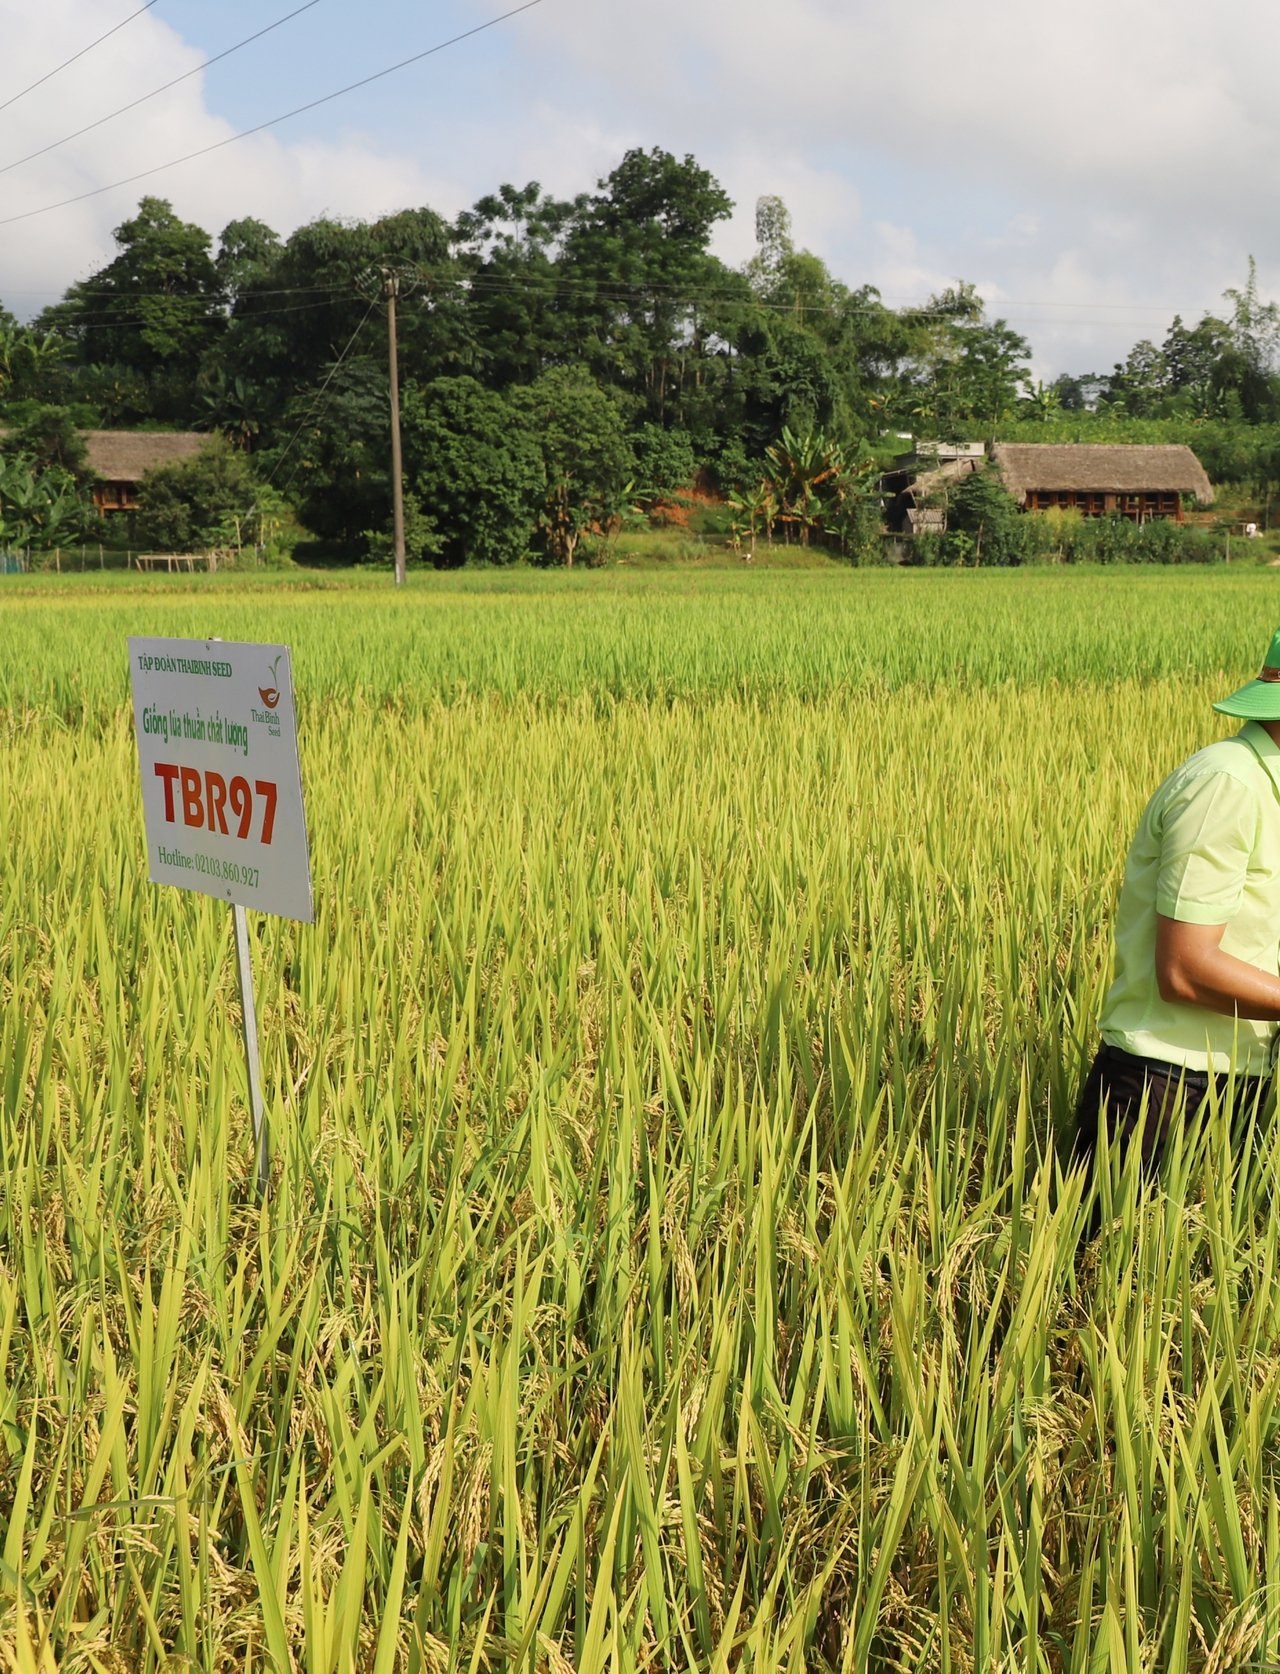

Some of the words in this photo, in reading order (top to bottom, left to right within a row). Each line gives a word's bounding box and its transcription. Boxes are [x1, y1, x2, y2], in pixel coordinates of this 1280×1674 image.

[138, 652, 154, 674] TẬP
[155, 654, 177, 672] ĐOÀN
[177, 658, 212, 676] THAIBINH
[212, 661, 233, 678] SEED
[143, 702, 168, 744] Giống
[169, 709, 182, 737] lúa
[183, 707, 206, 741] thuần
[207, 710, 223, 744] chất
[225, 717, 248, 756] lượng
[268, 726, 281, 737] Seed
[154, 762, 277, 845] TBR97
[158, 846, 195, 870] Hotline:
[195, 853, 260, 888] 02103.860.927
